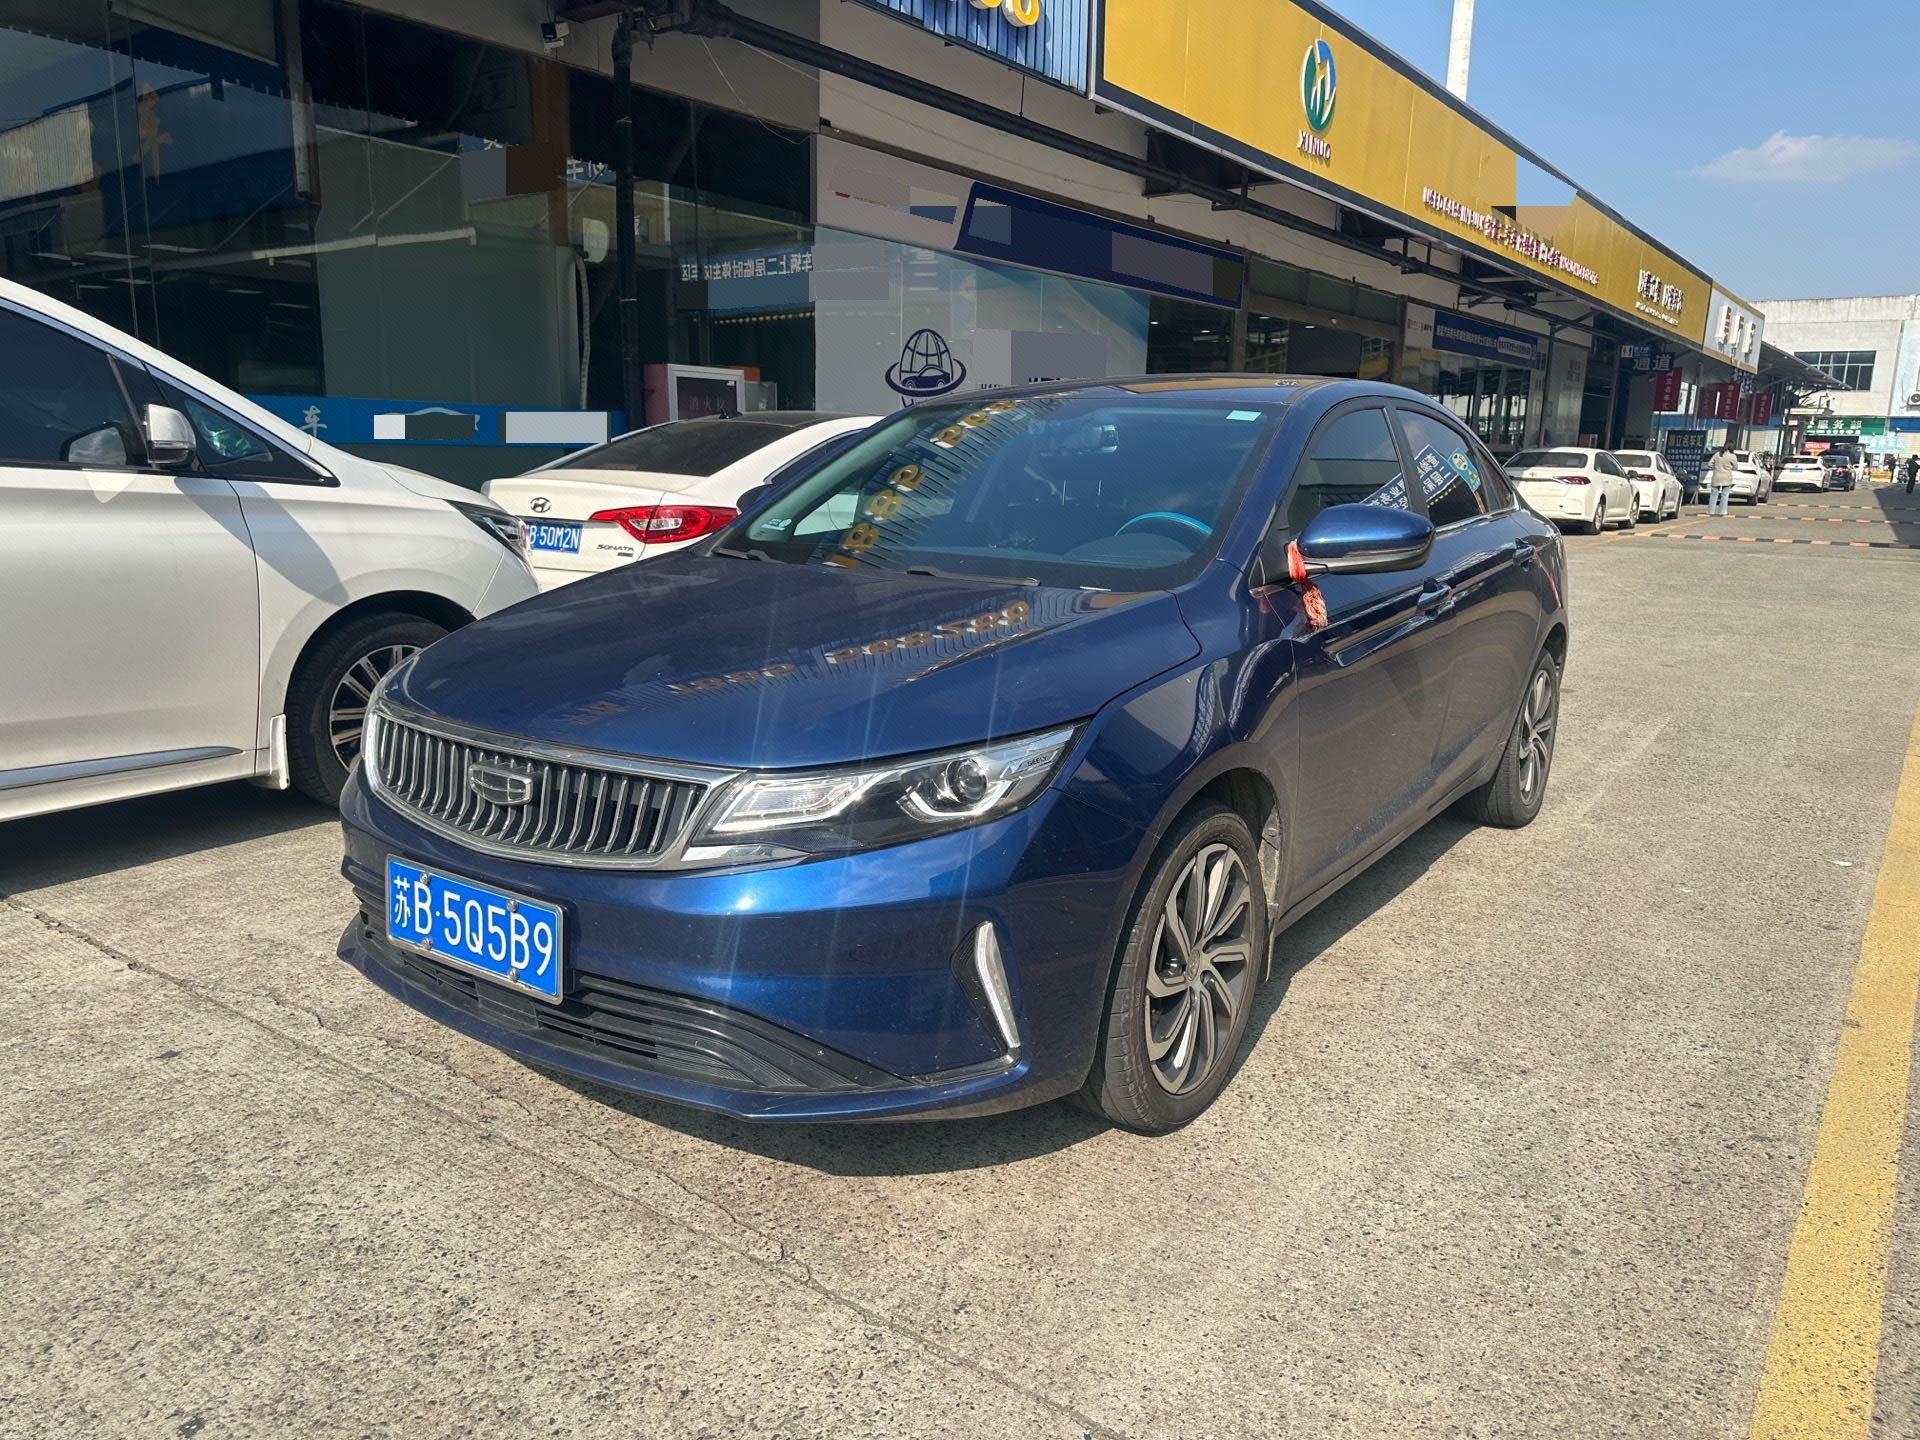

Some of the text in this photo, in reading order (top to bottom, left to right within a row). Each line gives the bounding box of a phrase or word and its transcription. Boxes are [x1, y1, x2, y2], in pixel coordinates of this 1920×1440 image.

[1633, 354, 1672, 371] 通道
[527, 525, 580, 548] B·50M2N
[394, 875, 553, 976] 苏B·5Q5B9
